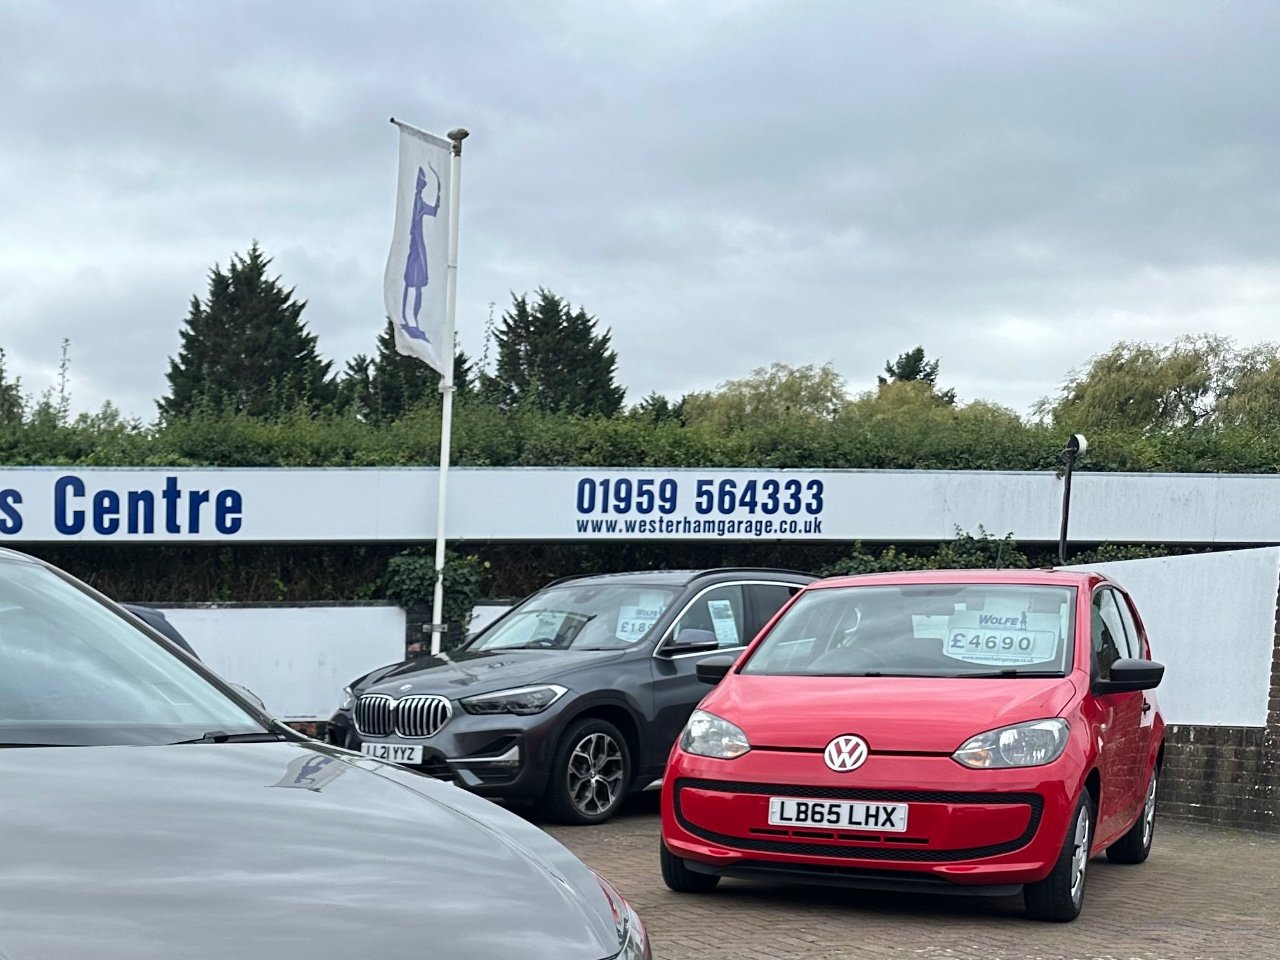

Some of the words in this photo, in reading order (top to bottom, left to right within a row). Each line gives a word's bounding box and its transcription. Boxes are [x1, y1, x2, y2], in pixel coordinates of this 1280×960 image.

[54, 476, 243, 535] Centre
[576, 478, 678, 514] 01959
[695, 478, 824, 515] 564333
[576, 516, 823, 536] www.westerhamgarage.co.uk
[978, 614, 1020, 626] WOLFE
[950, 633, 1031, 651] £4690
[393, 746, 415, 760] YYZ
[779, 801, 841, 824] LB65
[848, 805, 897, 827] LHX
